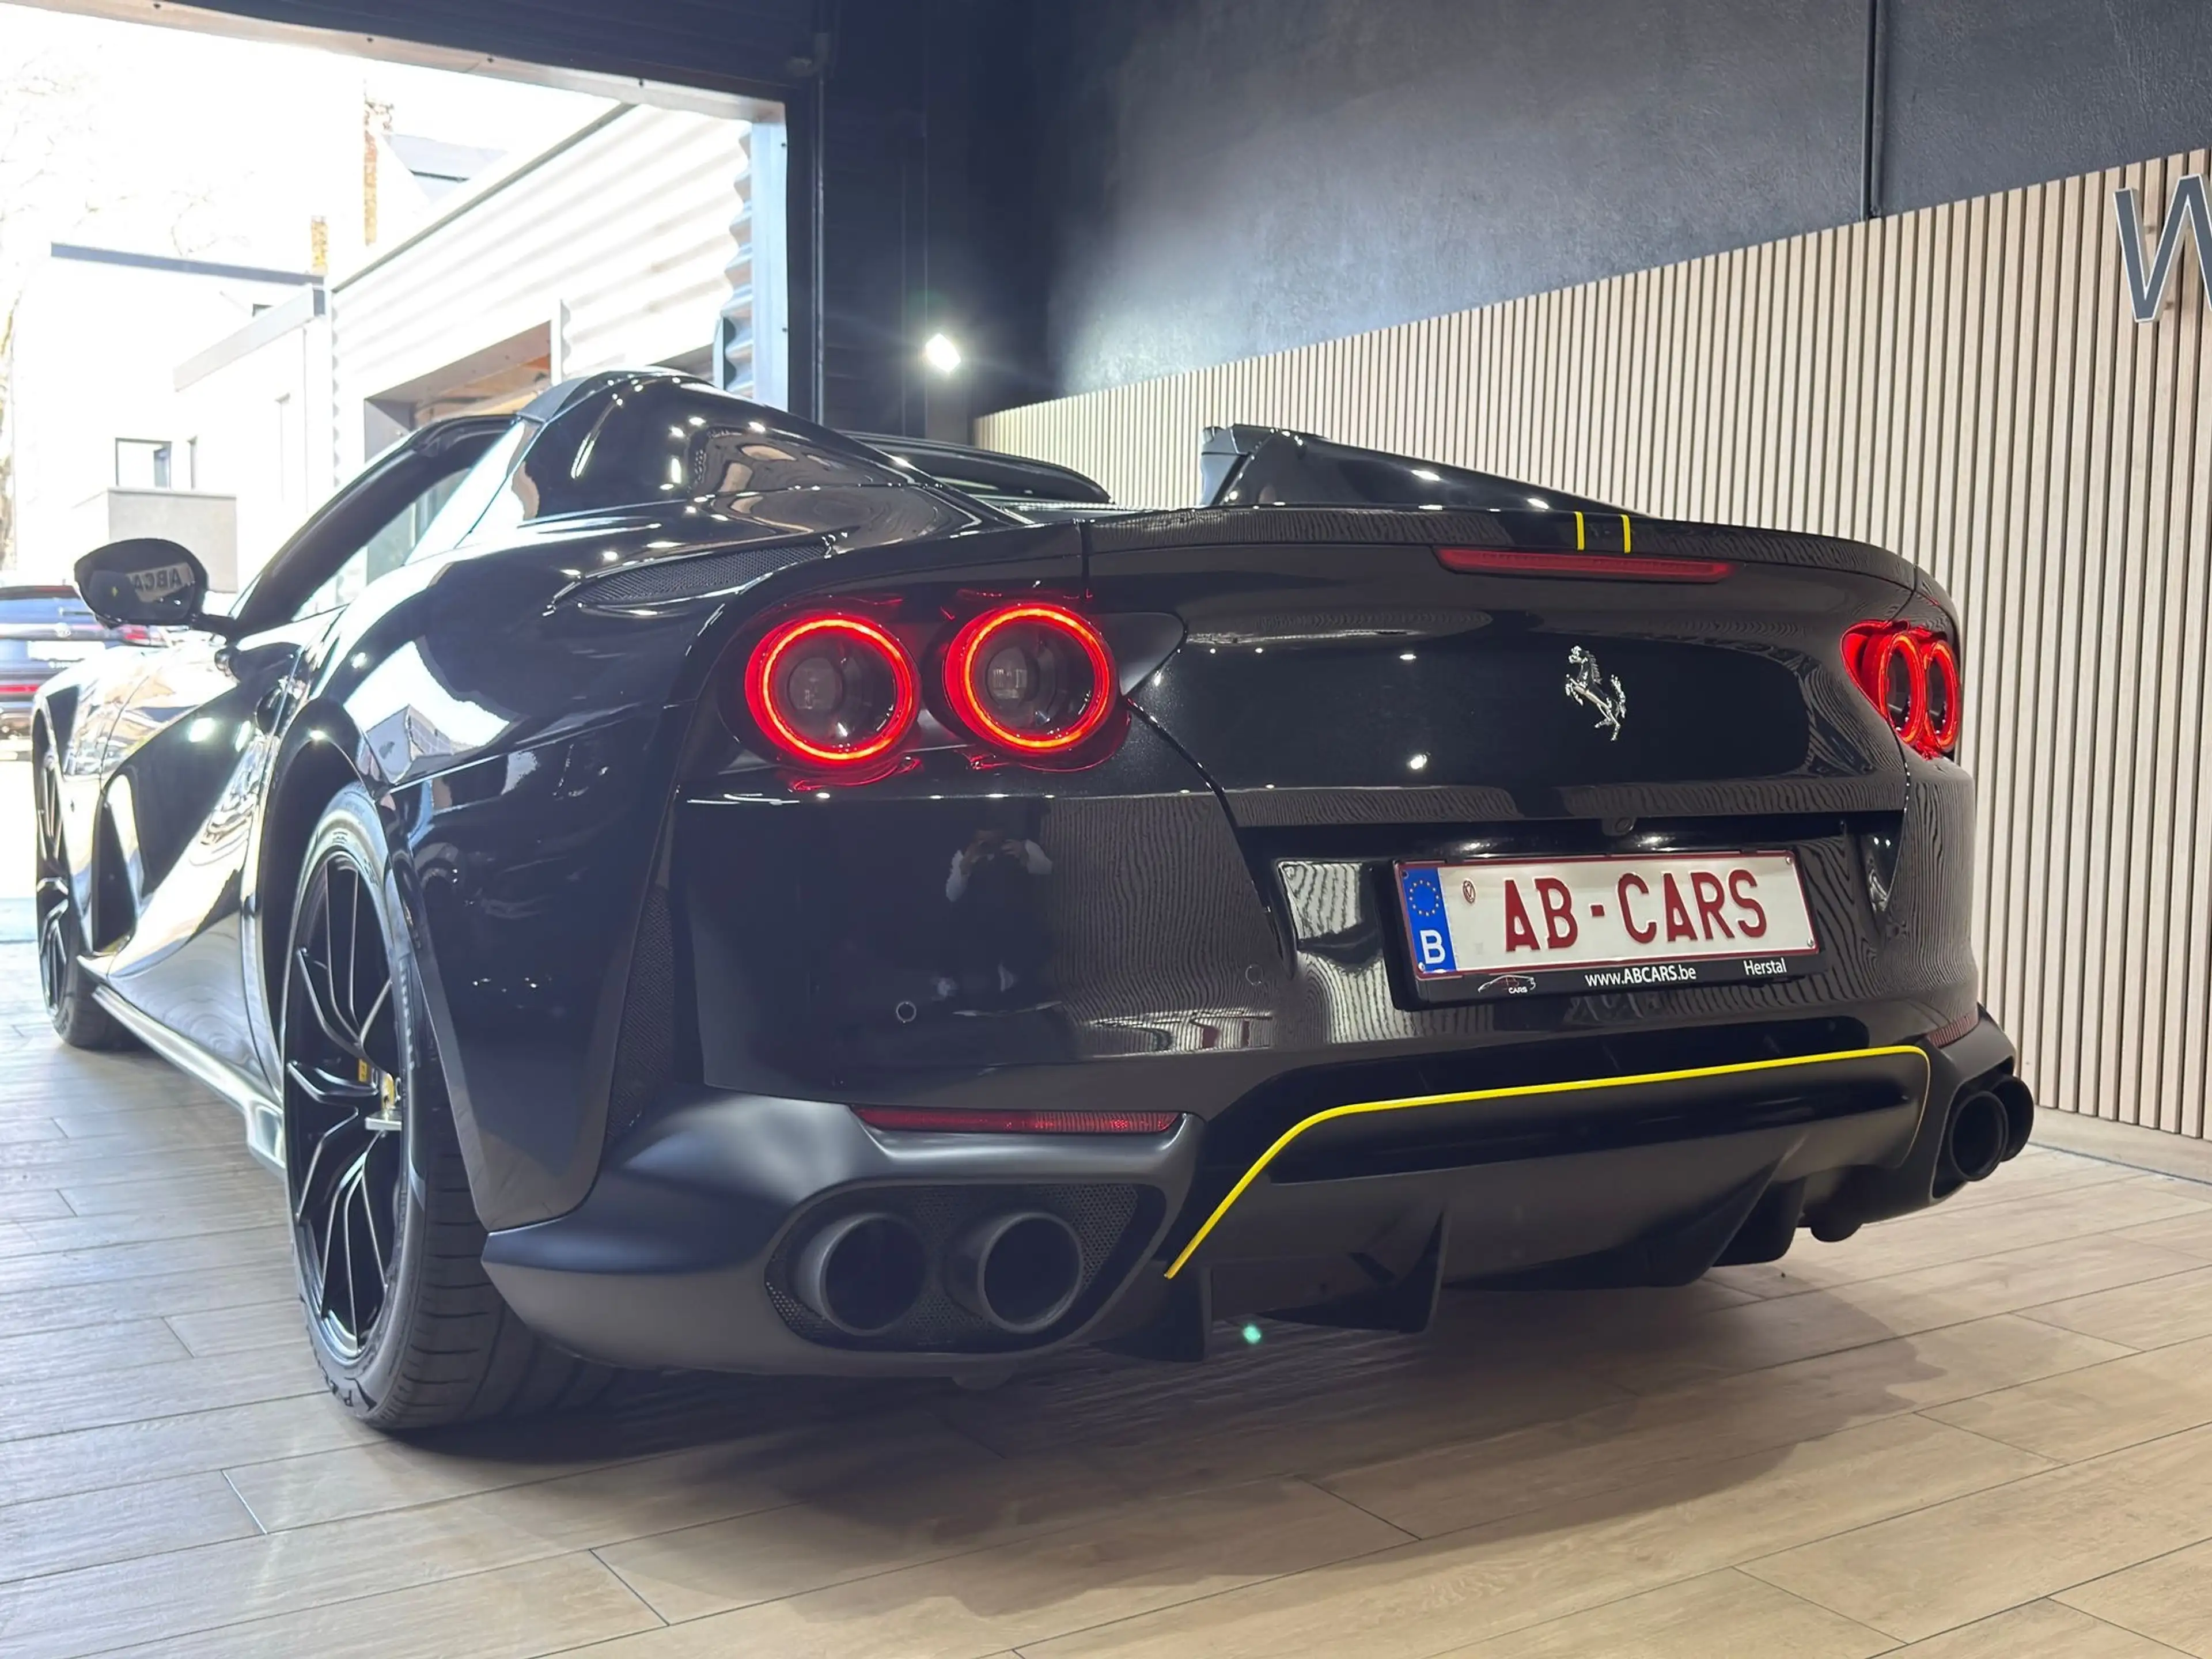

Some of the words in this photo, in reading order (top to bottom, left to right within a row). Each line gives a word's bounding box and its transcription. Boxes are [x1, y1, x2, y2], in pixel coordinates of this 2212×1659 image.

[1419, 929, 1446, 964] B
[1585, 965, 1696, 986] www.ABCARS.be
[1743, 957, 1787, 975] Herstal
